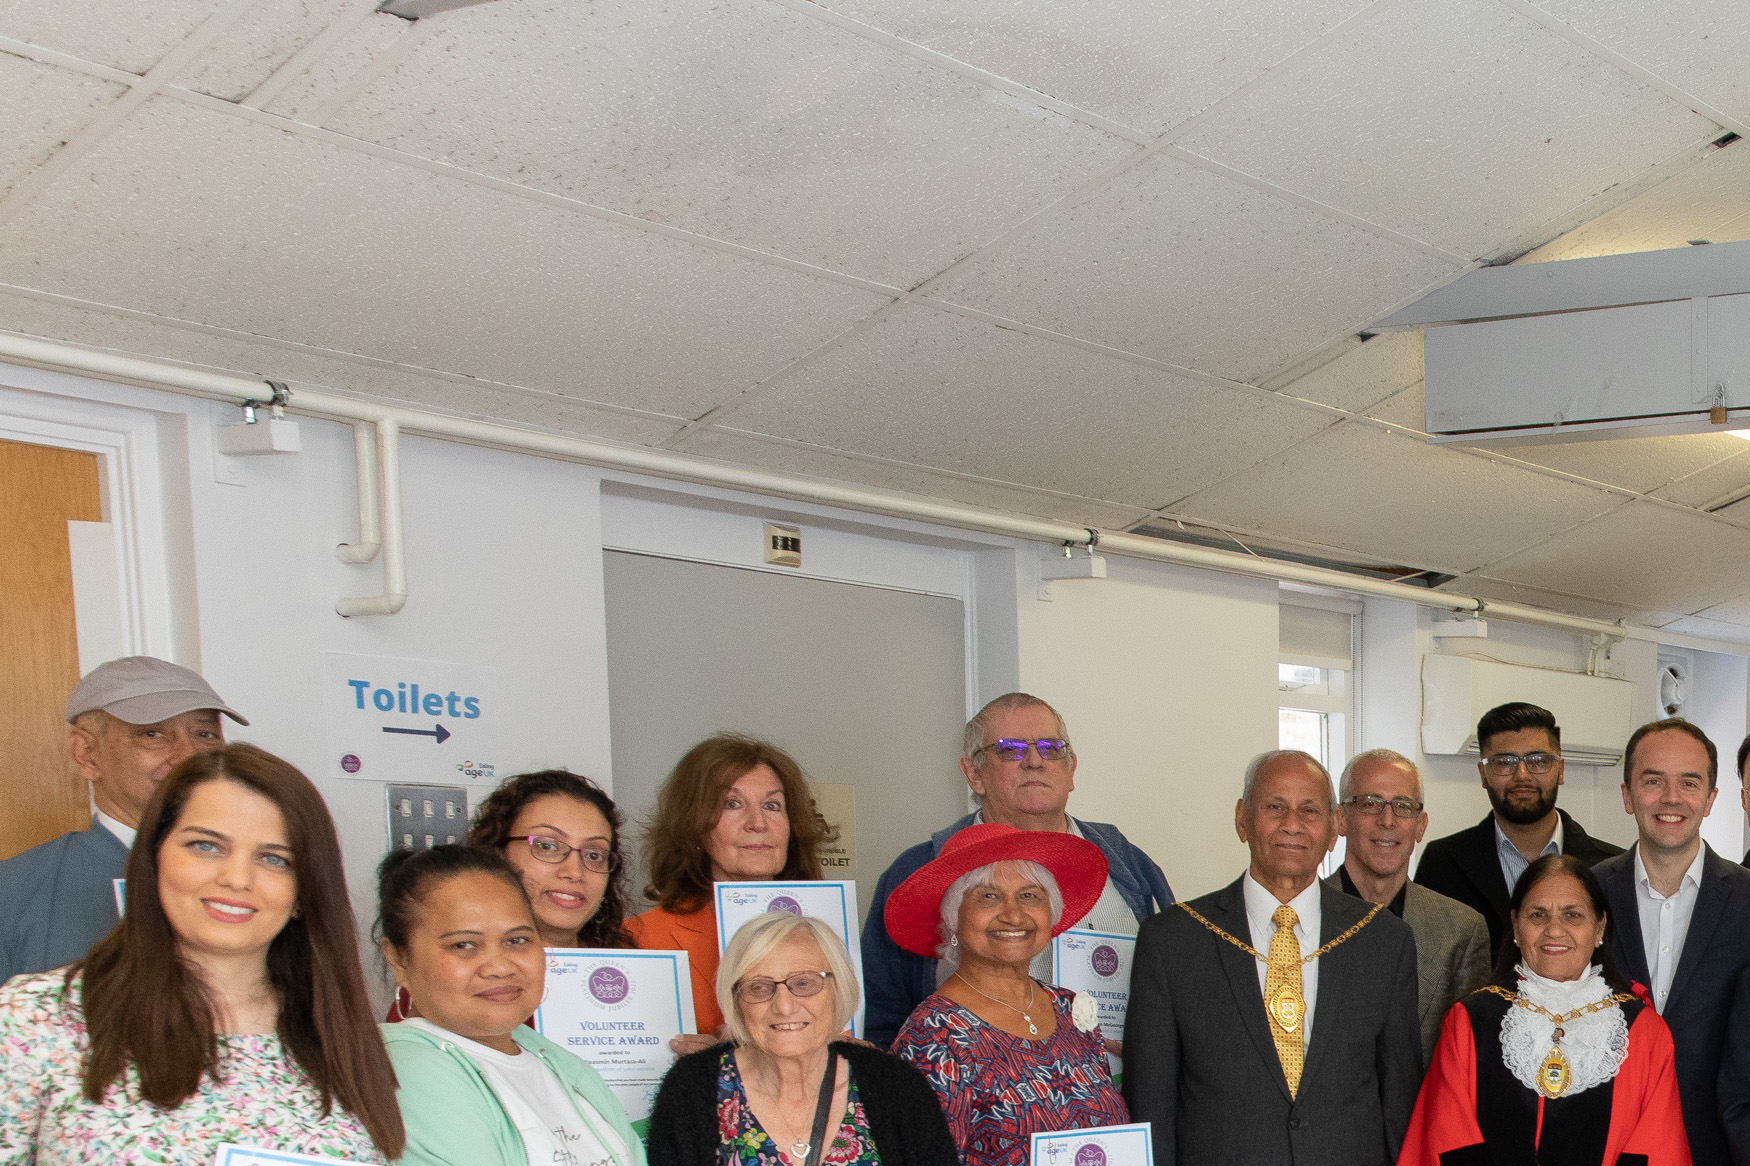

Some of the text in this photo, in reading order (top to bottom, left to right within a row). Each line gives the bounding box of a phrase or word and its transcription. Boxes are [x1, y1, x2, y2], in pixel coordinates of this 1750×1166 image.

[348, 679, 480, 719] Toilets
[465, 769, 482, 778] age
[821, 858, 850, 866] OILET
[580, 1021, 645, 1030] VOLUNTEER
[568, 1035, 659, 1045] SERVICE AWARD
